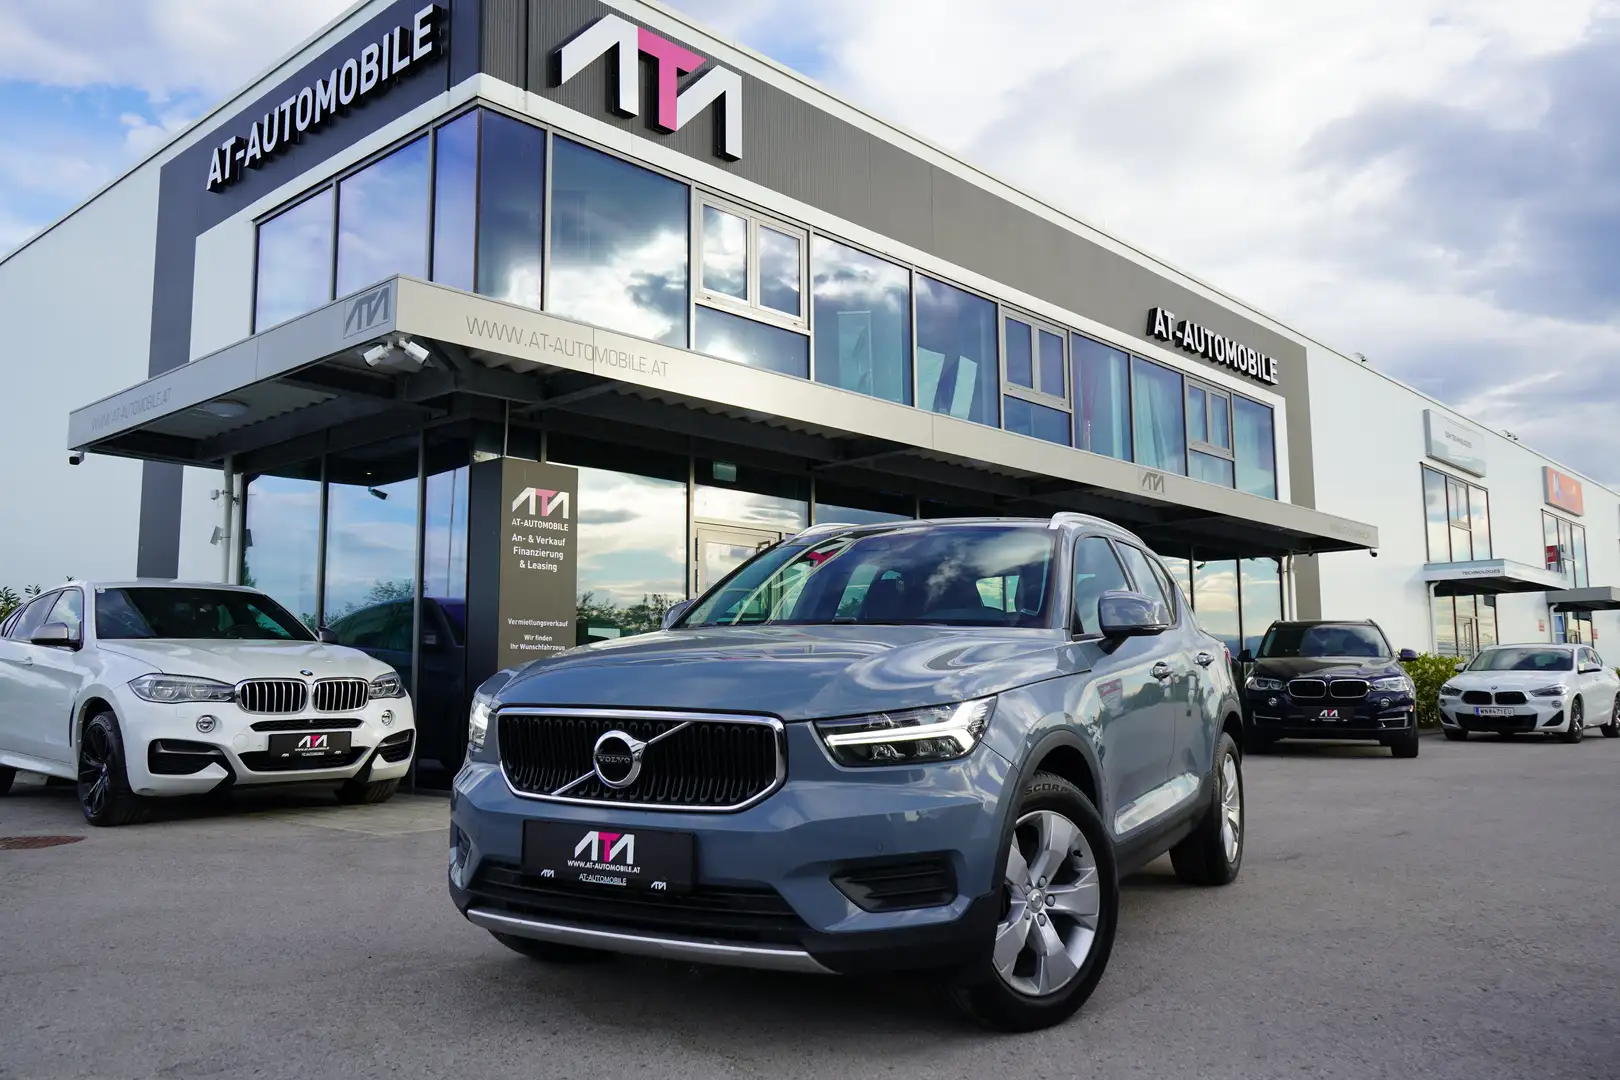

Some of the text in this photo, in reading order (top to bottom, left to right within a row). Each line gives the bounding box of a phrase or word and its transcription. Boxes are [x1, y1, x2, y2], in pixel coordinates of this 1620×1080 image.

[206, 3, 435, 191] AT-AUTOMOBILE
[465, 315, 669, 378] WWW.AT-AUTOMOBILE.AT
[1152, 306, 1279, 385] AT-AUTOMOBILE
[511, 518, 569, 531] AT-AUTOMOBILE
[511, 533, 566, 546] An- & Verkauf
[513, 546, 564, 560] Finanzierung
[519, 559, 558, 573] & Leasing
[597, 755, 631, 763] VOLVO
[567, 859, 641, 874] WWW.AT-AUTOMOBILE.AT
[578, 873, 627, 886] AT-AUTOMOBILE
